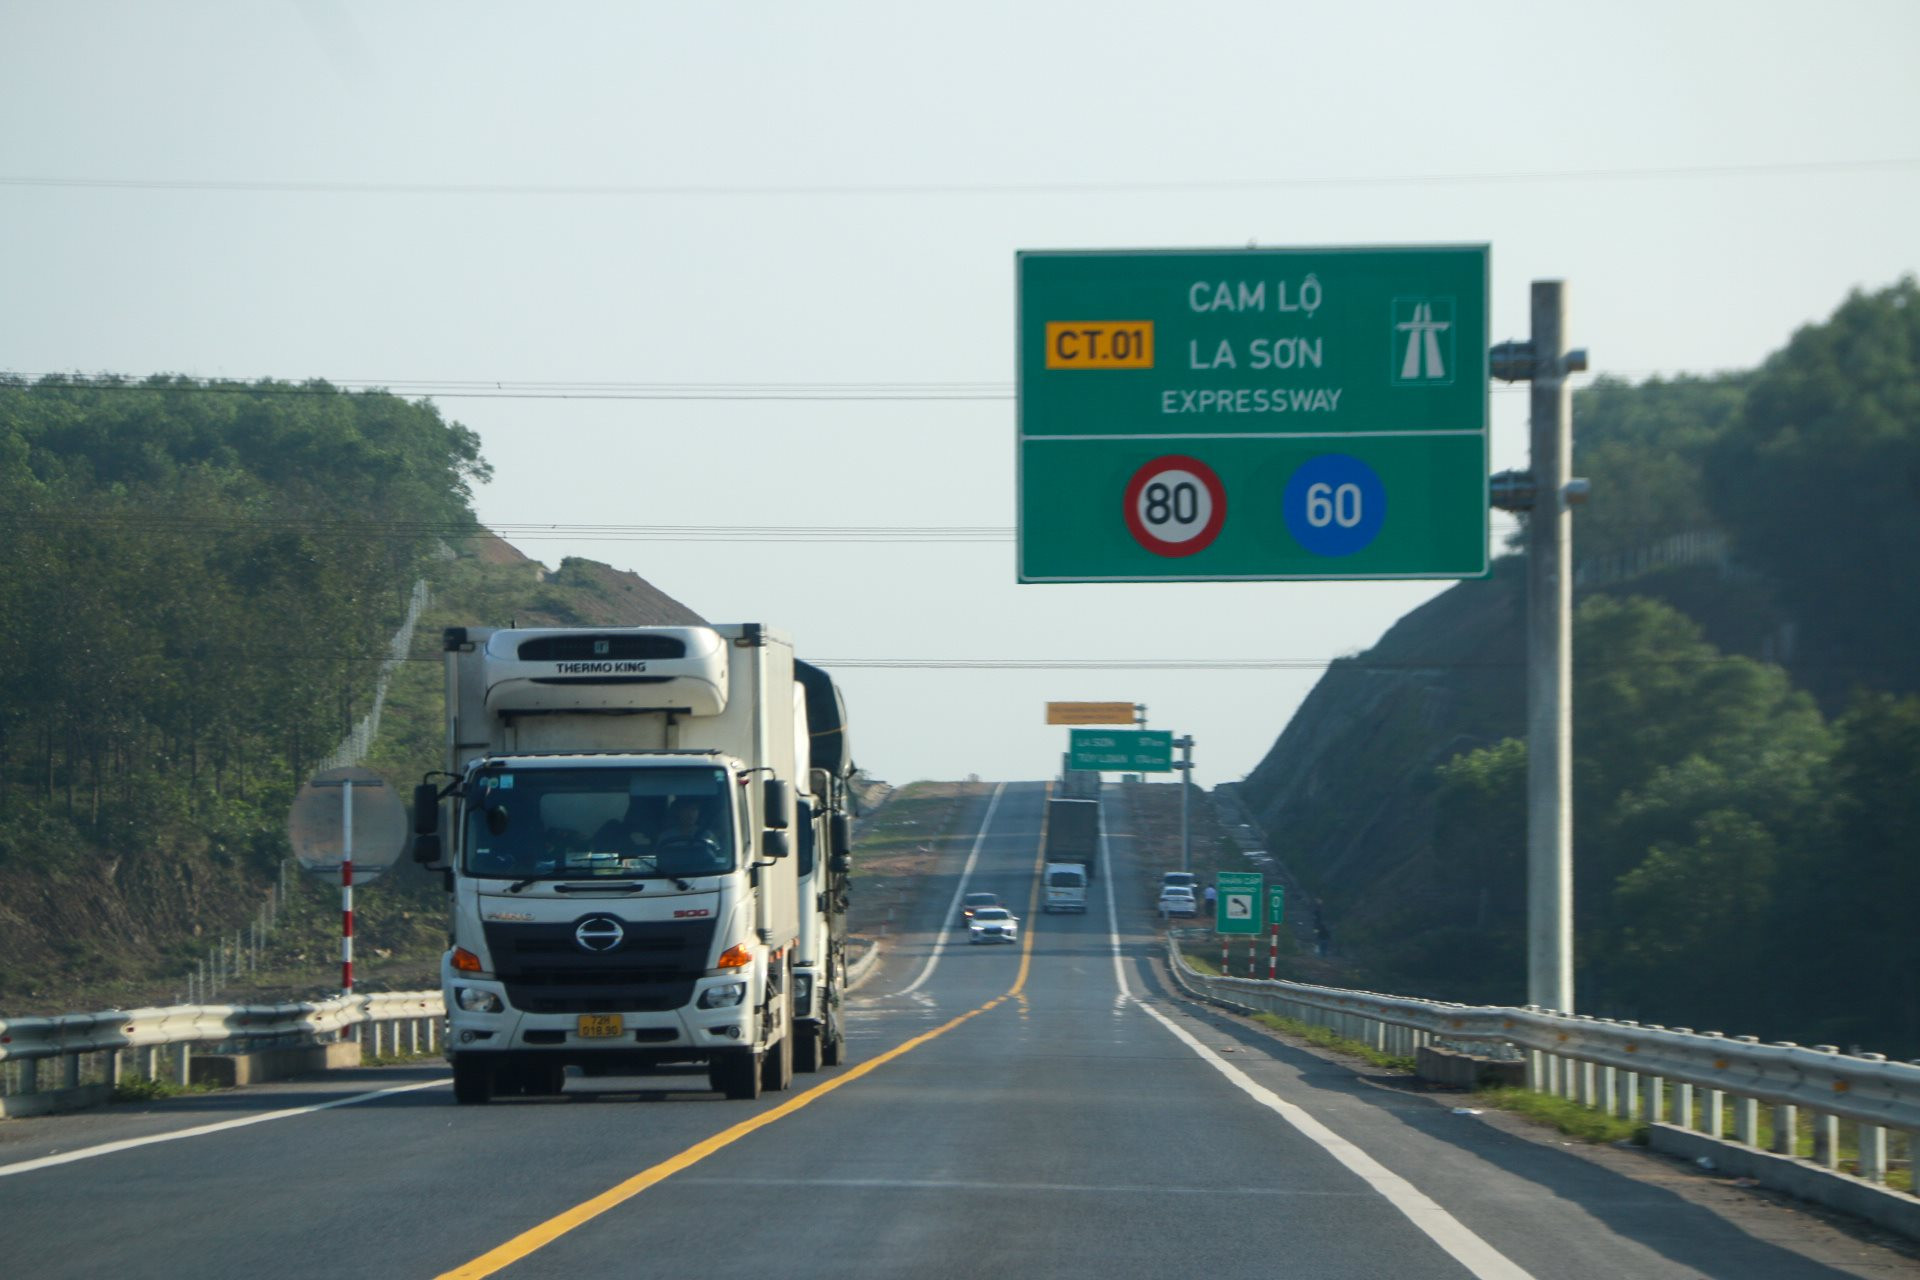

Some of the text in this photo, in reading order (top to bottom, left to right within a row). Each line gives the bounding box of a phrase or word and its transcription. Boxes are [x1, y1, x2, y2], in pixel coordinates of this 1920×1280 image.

[1189, 272, 1322, 318] CAM LỘ
[1056, 329, 1144, 359] CT.01
[1190, 337, 1322, 369] LA SƠN
[1162, 388, 1342, 413] EXPRESSWAY
[1145, 482, 1198, 525] 80
[1306, 483, 1362, 527] 60
[556, 661, 646, 673] THERMO KING
[673, 909, 709, 918] 500
